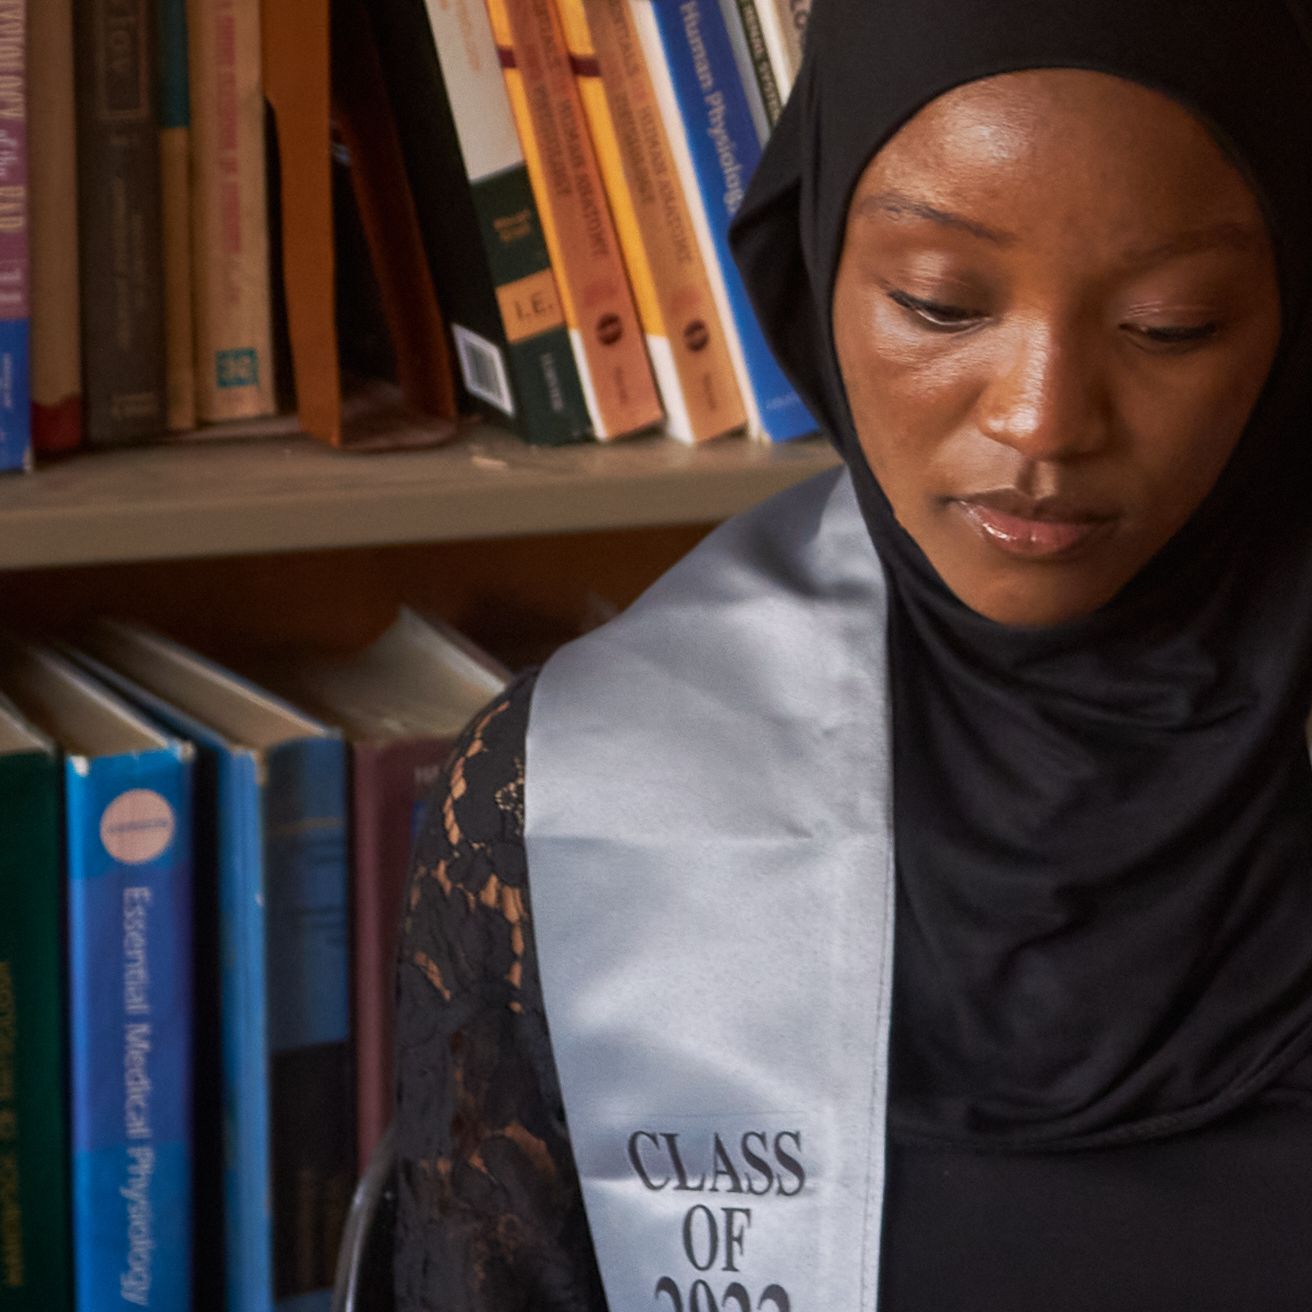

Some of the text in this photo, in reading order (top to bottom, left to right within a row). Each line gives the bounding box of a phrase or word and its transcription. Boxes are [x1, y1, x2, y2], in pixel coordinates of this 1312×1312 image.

[679, 0, 713, 90] Human
[118, 885, 155, 1308] Essential Medical Physiology
[625, 1129, 807, 1197] CLASS
[681, 1203, 753, 1272] OF
